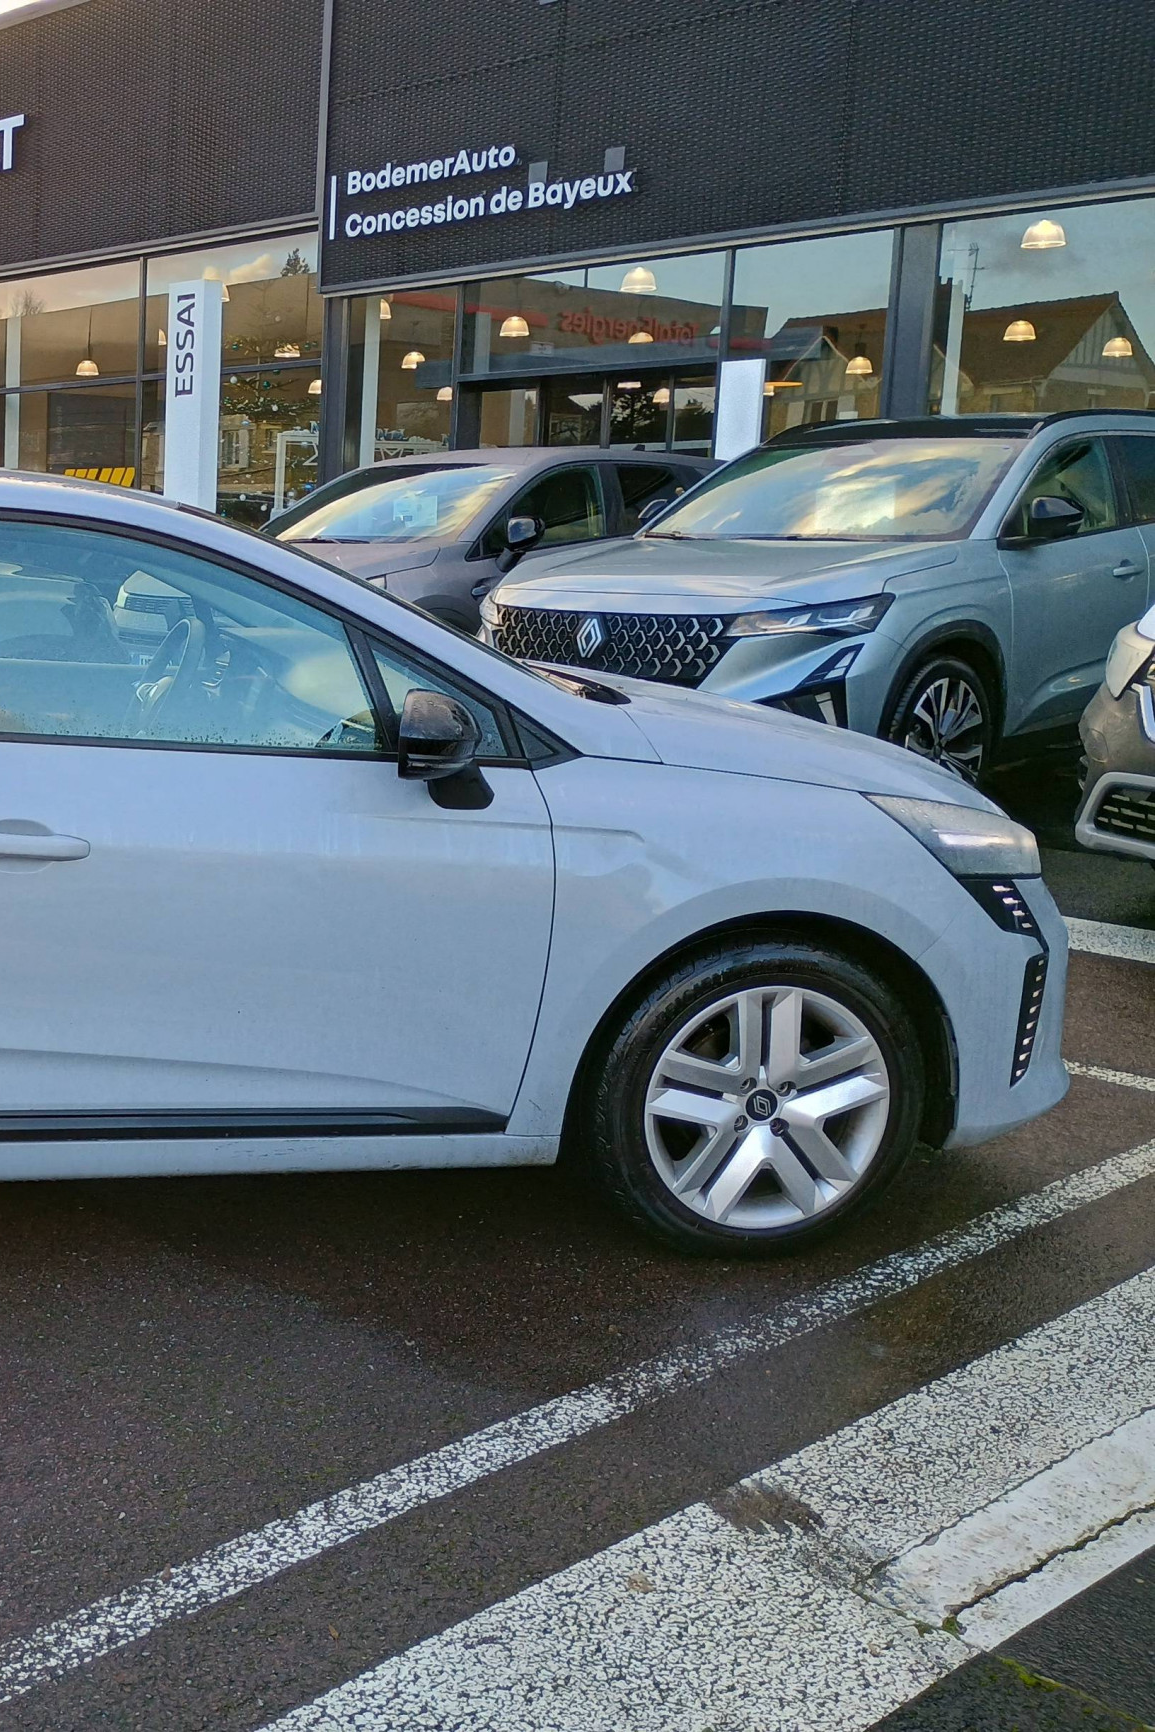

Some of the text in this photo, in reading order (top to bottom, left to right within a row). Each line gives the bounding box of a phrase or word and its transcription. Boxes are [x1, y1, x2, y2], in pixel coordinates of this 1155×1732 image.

[345, 170, 634, 238] Concession de Bayeux
[347, 145, 516, 196] BodemerAuto
[174, 292, 196, 398] ESSAI
